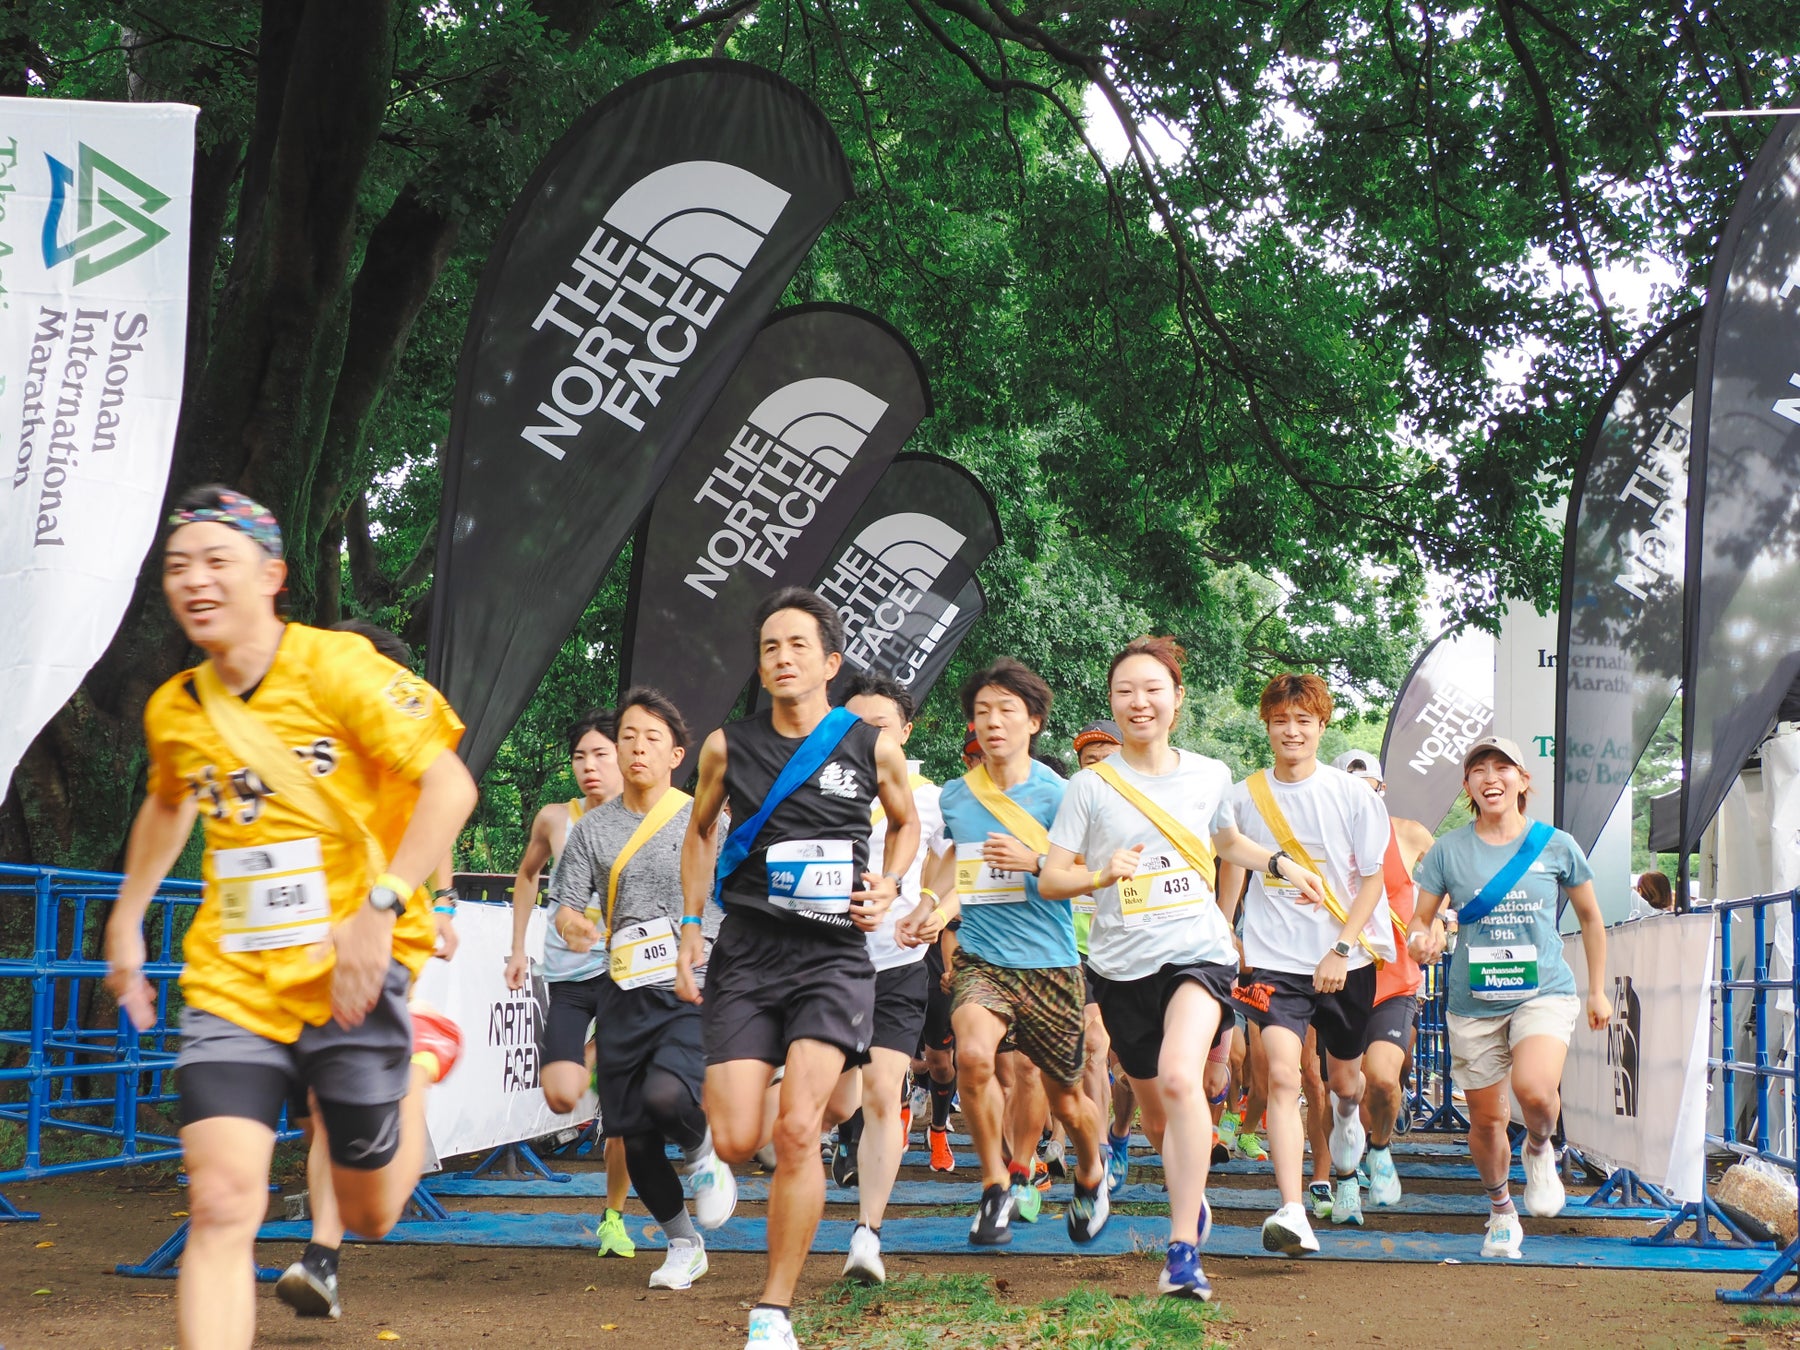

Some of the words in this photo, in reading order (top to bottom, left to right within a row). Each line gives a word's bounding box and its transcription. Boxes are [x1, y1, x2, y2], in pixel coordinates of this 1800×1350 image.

[532, 226, 637, 337] THE
[14, 305, 68, 489] Marathon
[92, 311, 148, 452] Shonan
[521, 251, 681, 460] NORTH
[600, 277, 724, 431] FACE
[33, 307, 108, 549] International
[694, 425, 773, 508] THE
[1619, 421, 1690, 508] THE
[684, 444, 806, 599] NORTH
[743, 463, 837, 577] FACE
[1615, 499, 1678, 601] NOR
[838, 564, 899, 650] RTH
[844, 580, 923, 670] FACE
[1409, 694, 1477, 775] NORTH
[1415, 683, 1458, 727] THE
[1441, 703, 1494, 765] FACE
[816, 871, 842, 886] 213
[1124, 887, 1138, 898] 6h
[1164, 877, 1190, 894] 433
[644, 944, 667, 960] 405
[1481, 966, 1525, 975] Ambassador
[1490, 929, 1516, 941] 19th
[1485, 974, 1524, 988] Myaco
